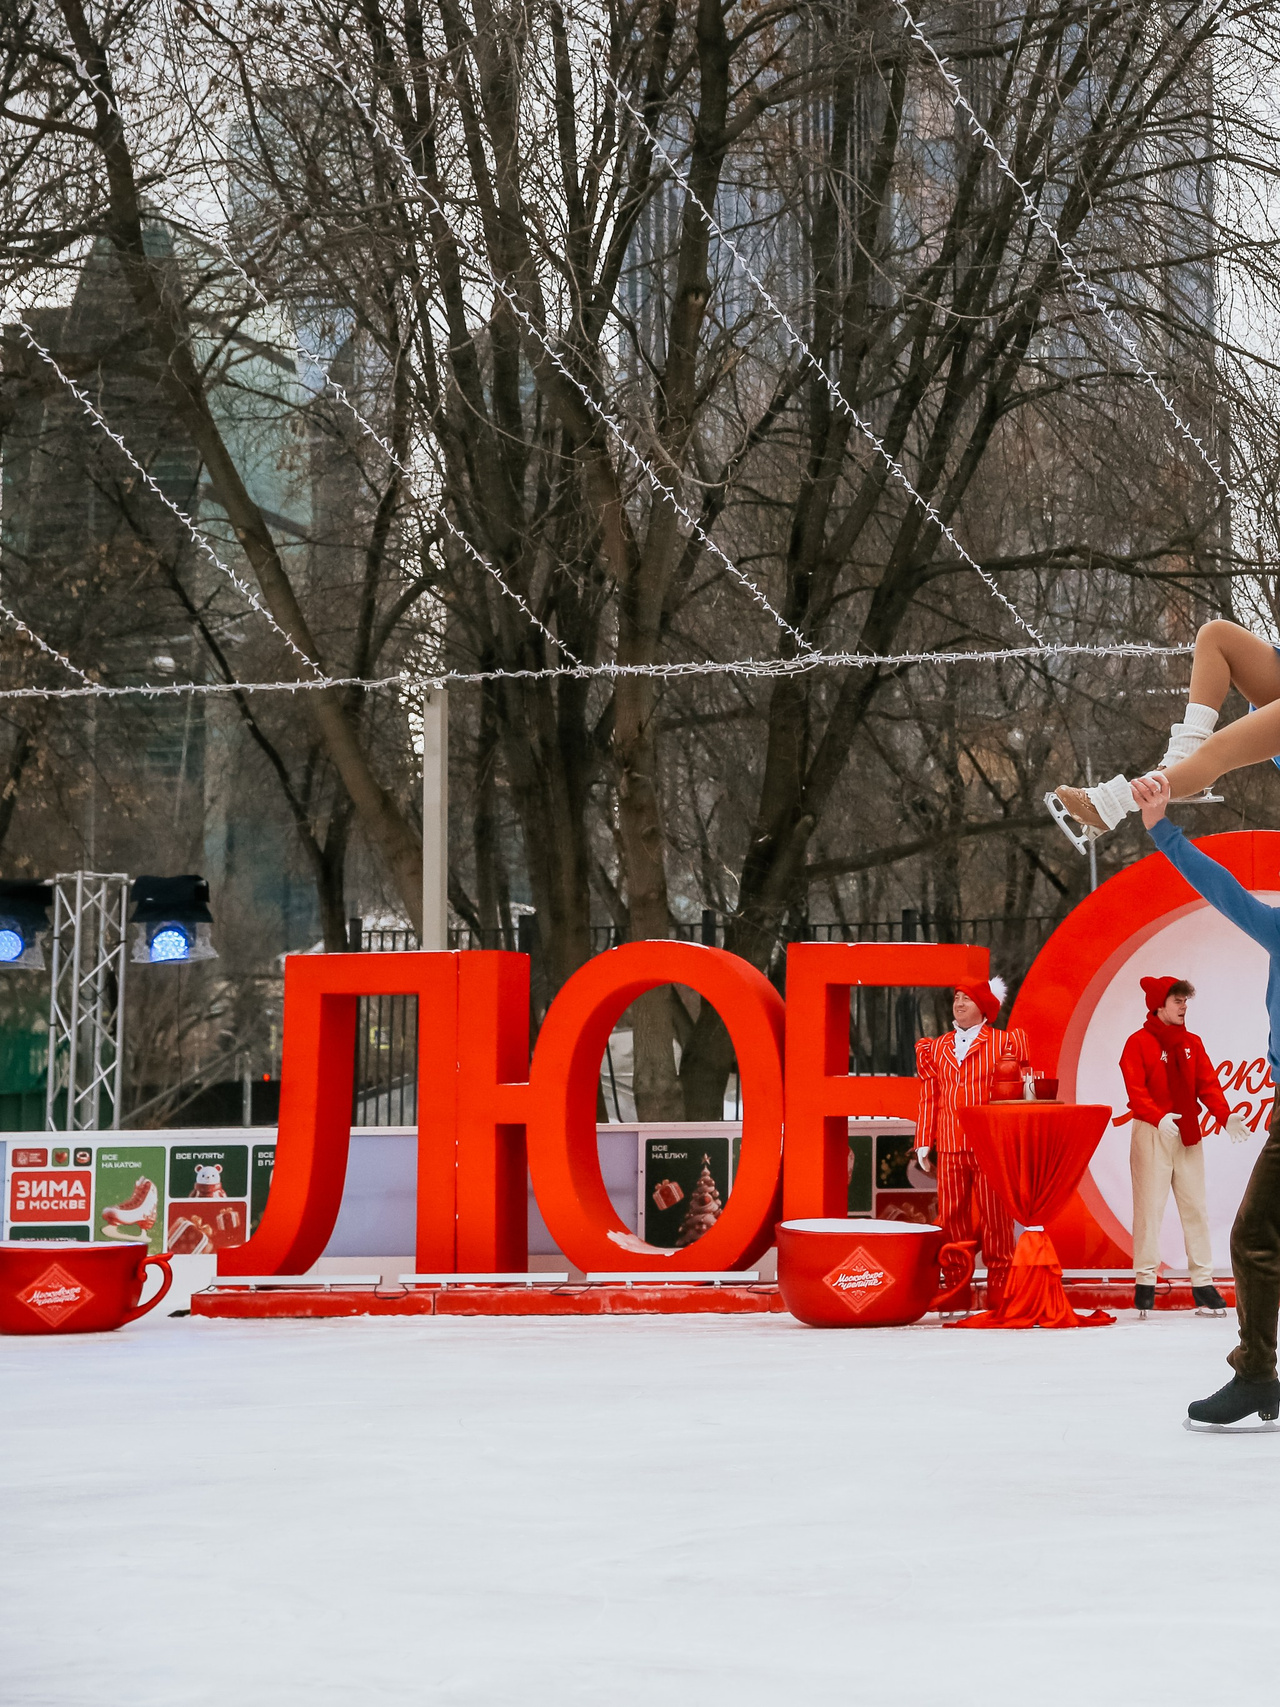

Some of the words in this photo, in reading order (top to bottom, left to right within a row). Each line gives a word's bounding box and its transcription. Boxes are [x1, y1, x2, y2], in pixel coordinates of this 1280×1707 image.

[101, 1153, 119, 1161] ВСЕ
[175, 1152, 192, 1160] ВСЕ
[16, 1179, 87, 1199] ЗИМА
[15, 1200, 26, 1211] В
[29, 1199, 87, 1210] МОСКВЕ
